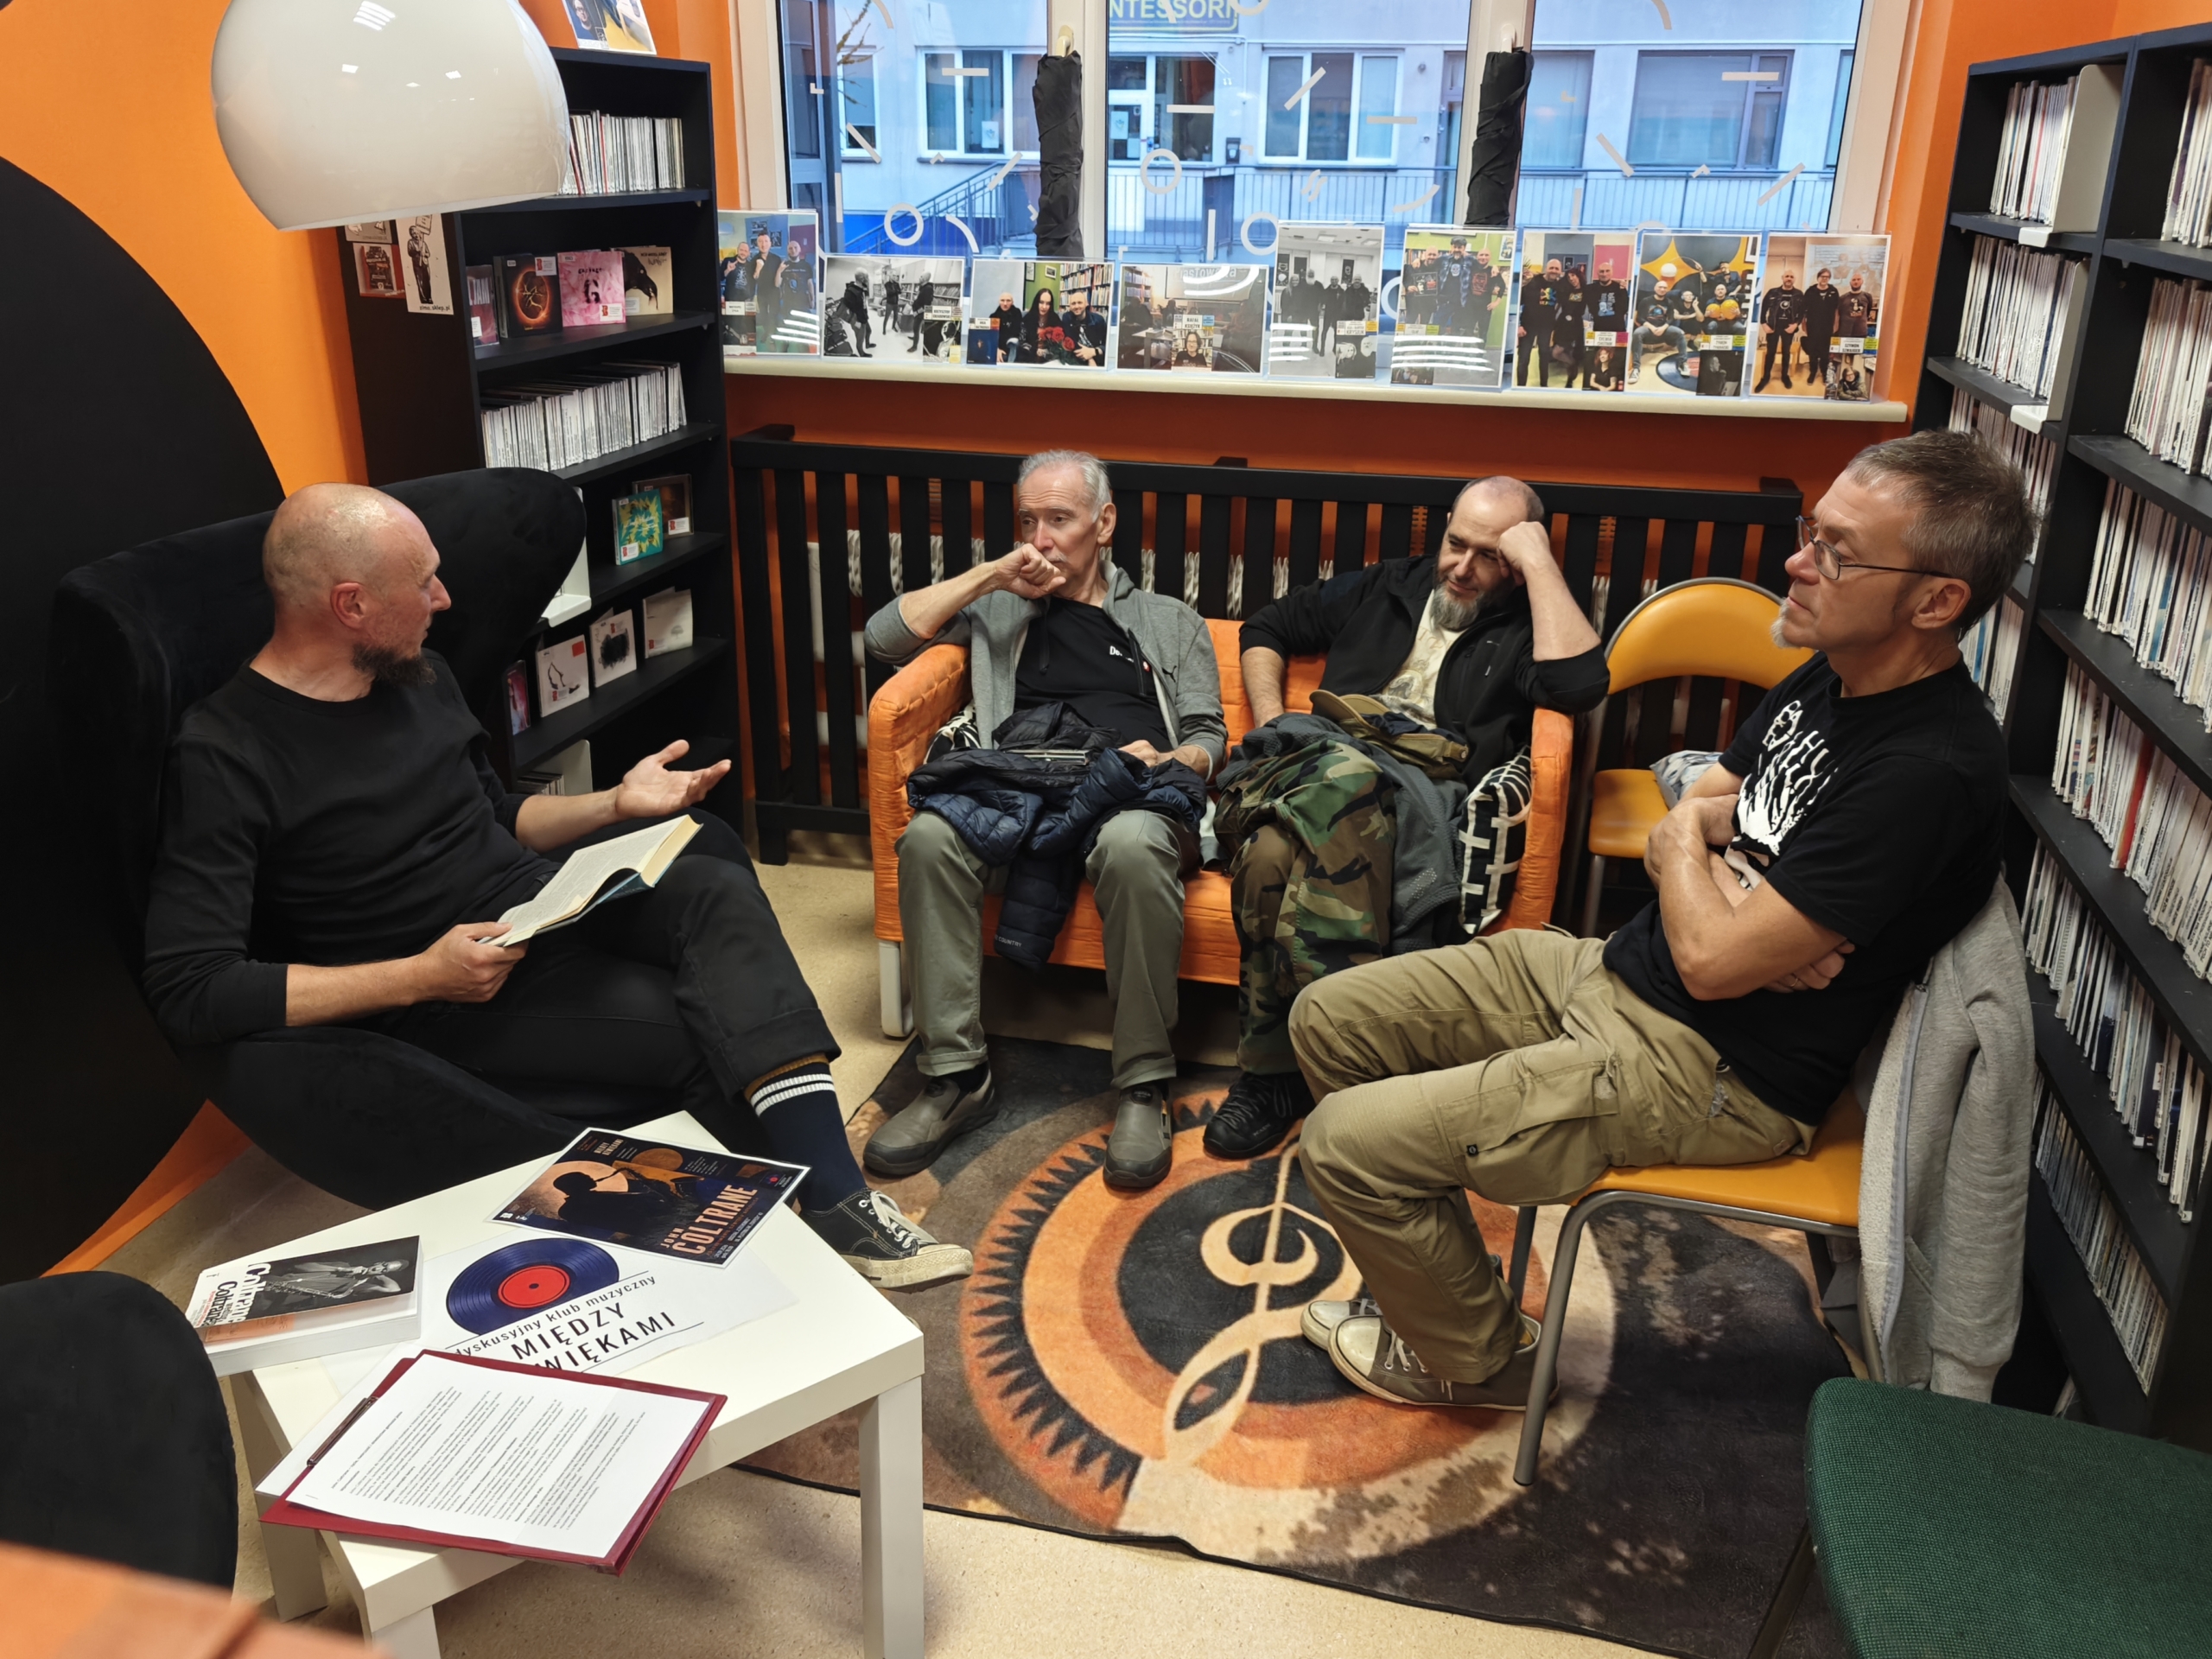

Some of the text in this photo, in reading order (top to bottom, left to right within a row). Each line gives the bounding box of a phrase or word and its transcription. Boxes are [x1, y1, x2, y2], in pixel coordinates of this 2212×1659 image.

[660, 1227, 685, 1249] JOHN
[671, 1185, 758, 1255] COLTRANE
[545, 1304, 581, 1322] klub
[585, 1276, 656, 1306] muzyczny
[511, 1302, 624, 1360] MIĘDZY
[535, 1312, 675, 1370] WIĘKAMI
